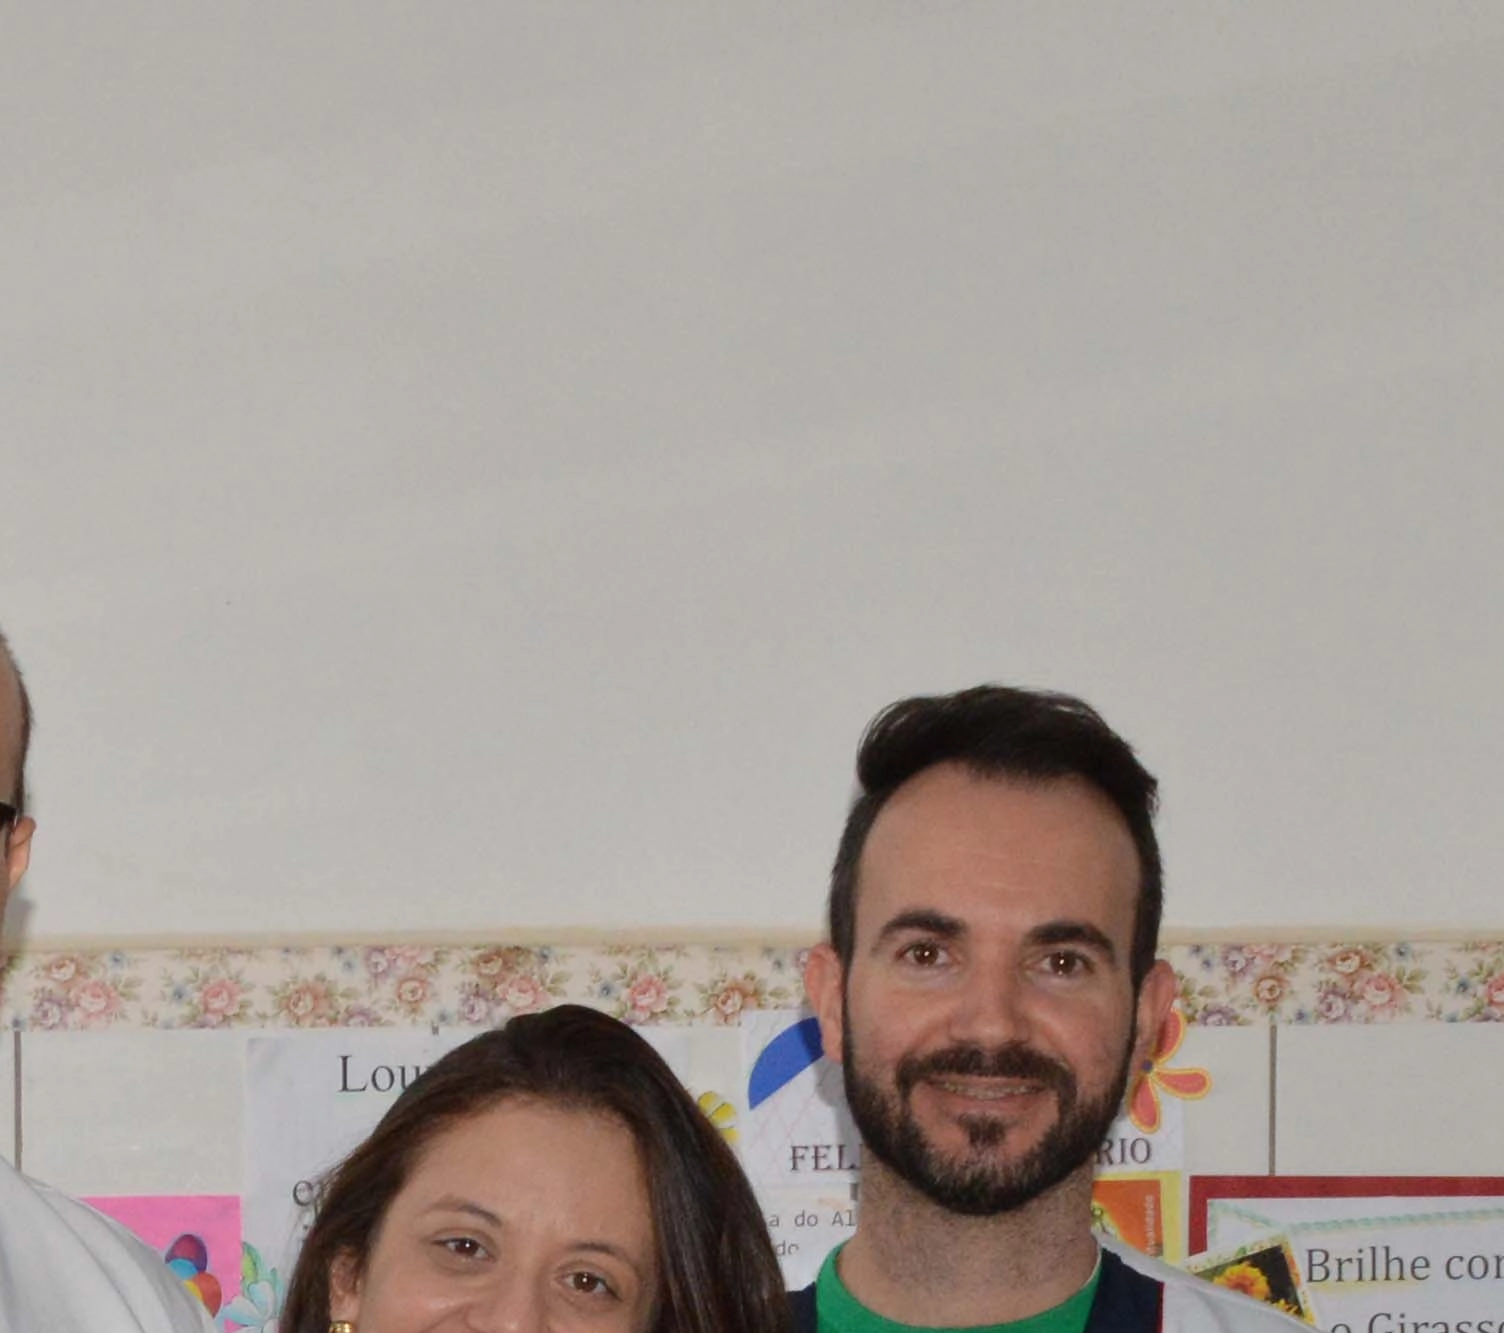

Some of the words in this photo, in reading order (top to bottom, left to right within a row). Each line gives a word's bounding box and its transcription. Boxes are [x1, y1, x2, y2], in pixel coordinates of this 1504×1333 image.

[338, 1055, 423, 1093] Lou
[1096, 1137, 1151, 1166] RIO
[831, 1209, 856, 1227] Al
[1306, 1245, 1431, 1283] Brilhe
